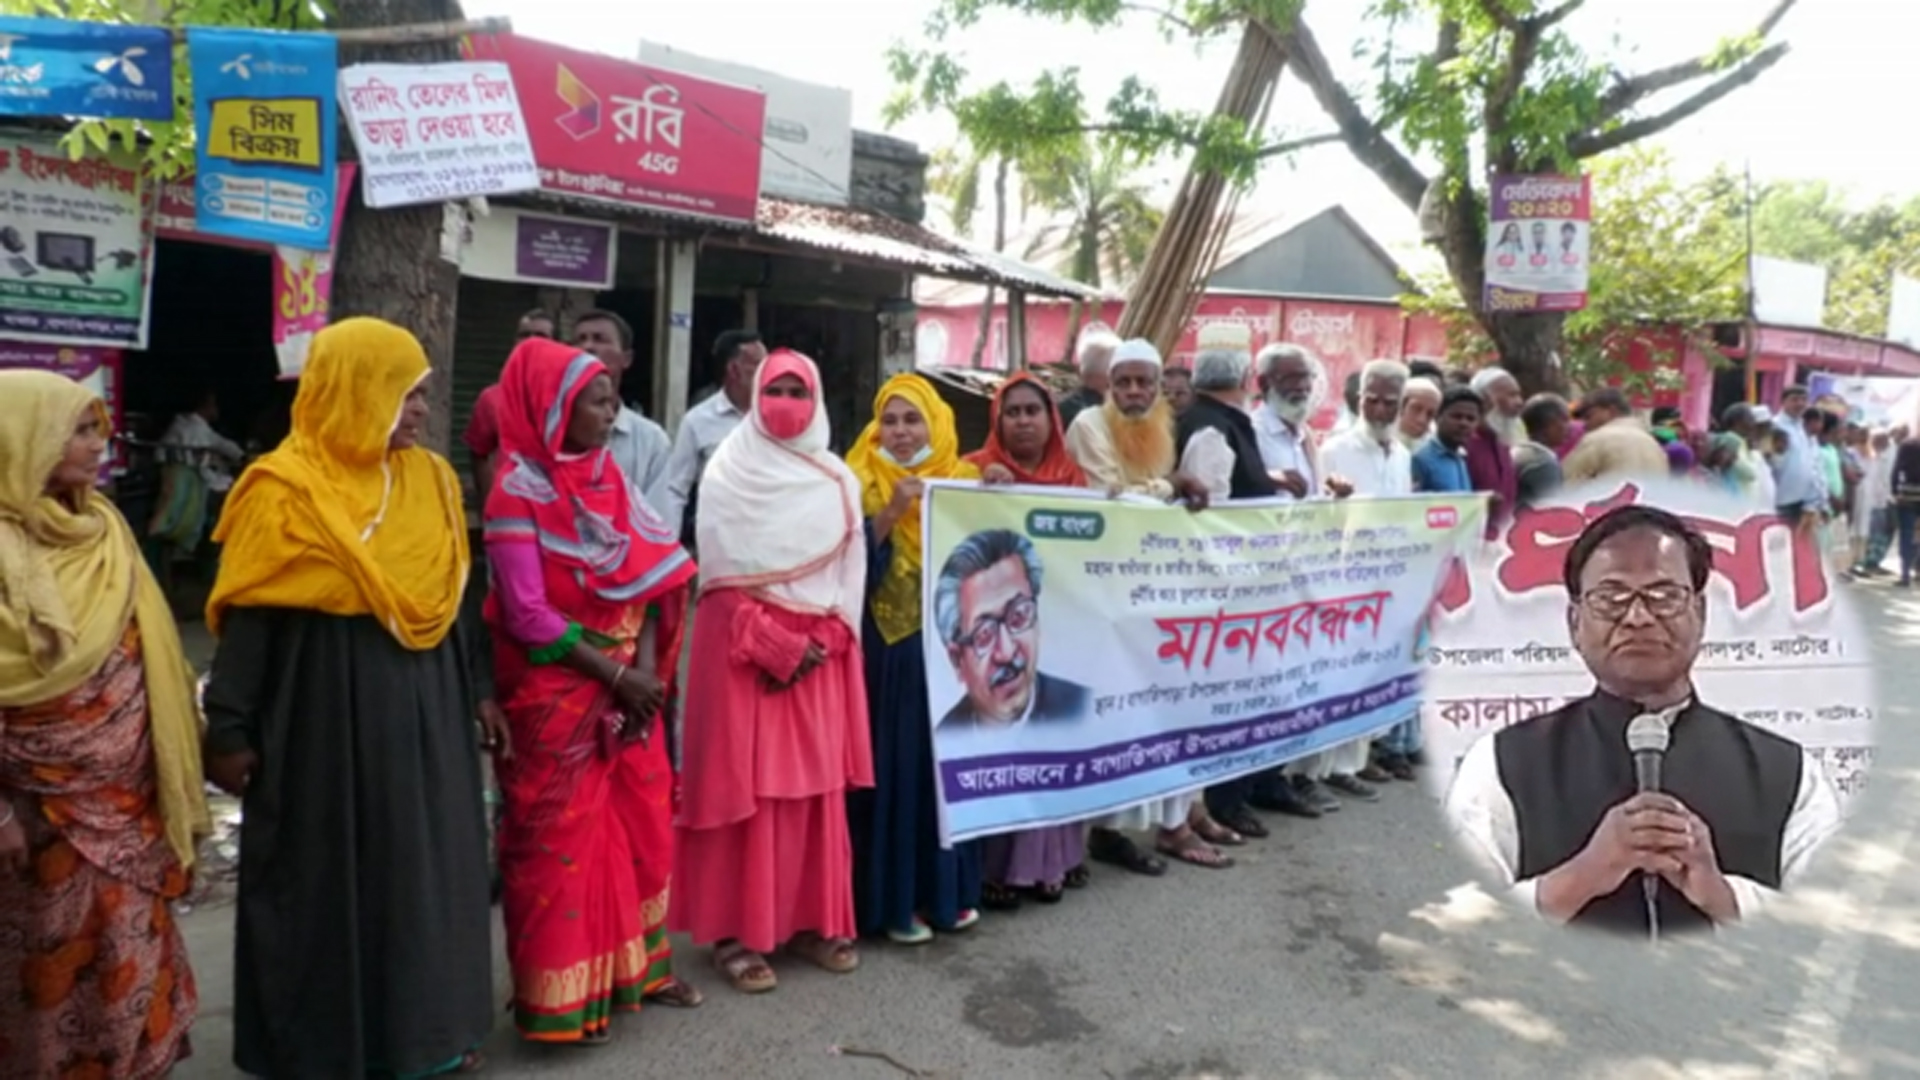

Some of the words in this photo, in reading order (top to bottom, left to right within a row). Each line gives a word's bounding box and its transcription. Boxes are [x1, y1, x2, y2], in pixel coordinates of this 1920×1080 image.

[350, 77, 405, 112] রানিং
[407, 82, 470, 110] তেলের
[472, 73, 511, 104] মিল
[249, 103, 294, 133] সিম
[361, 117, 411, 150] ভাড়া
[417, 114, 476, 143] দেওয়া
[477, 112, 516, 138] হবে
[610, 84, 684, 149] রবি
[229, 125, 300, 159] বিক্রয়
[1154, 590, 1393, 672] মানববন্ধন
[1429, 645, 1504, 667] উপজেলা
[1511, 640, 1571, 663] পরিষদ
[955, 762, 1067, 793] আয়োজনে
[1090, 738, 1181, 777] বাগাতিপাড়া
[1184, 725, 1249, 756] উপজেলা
